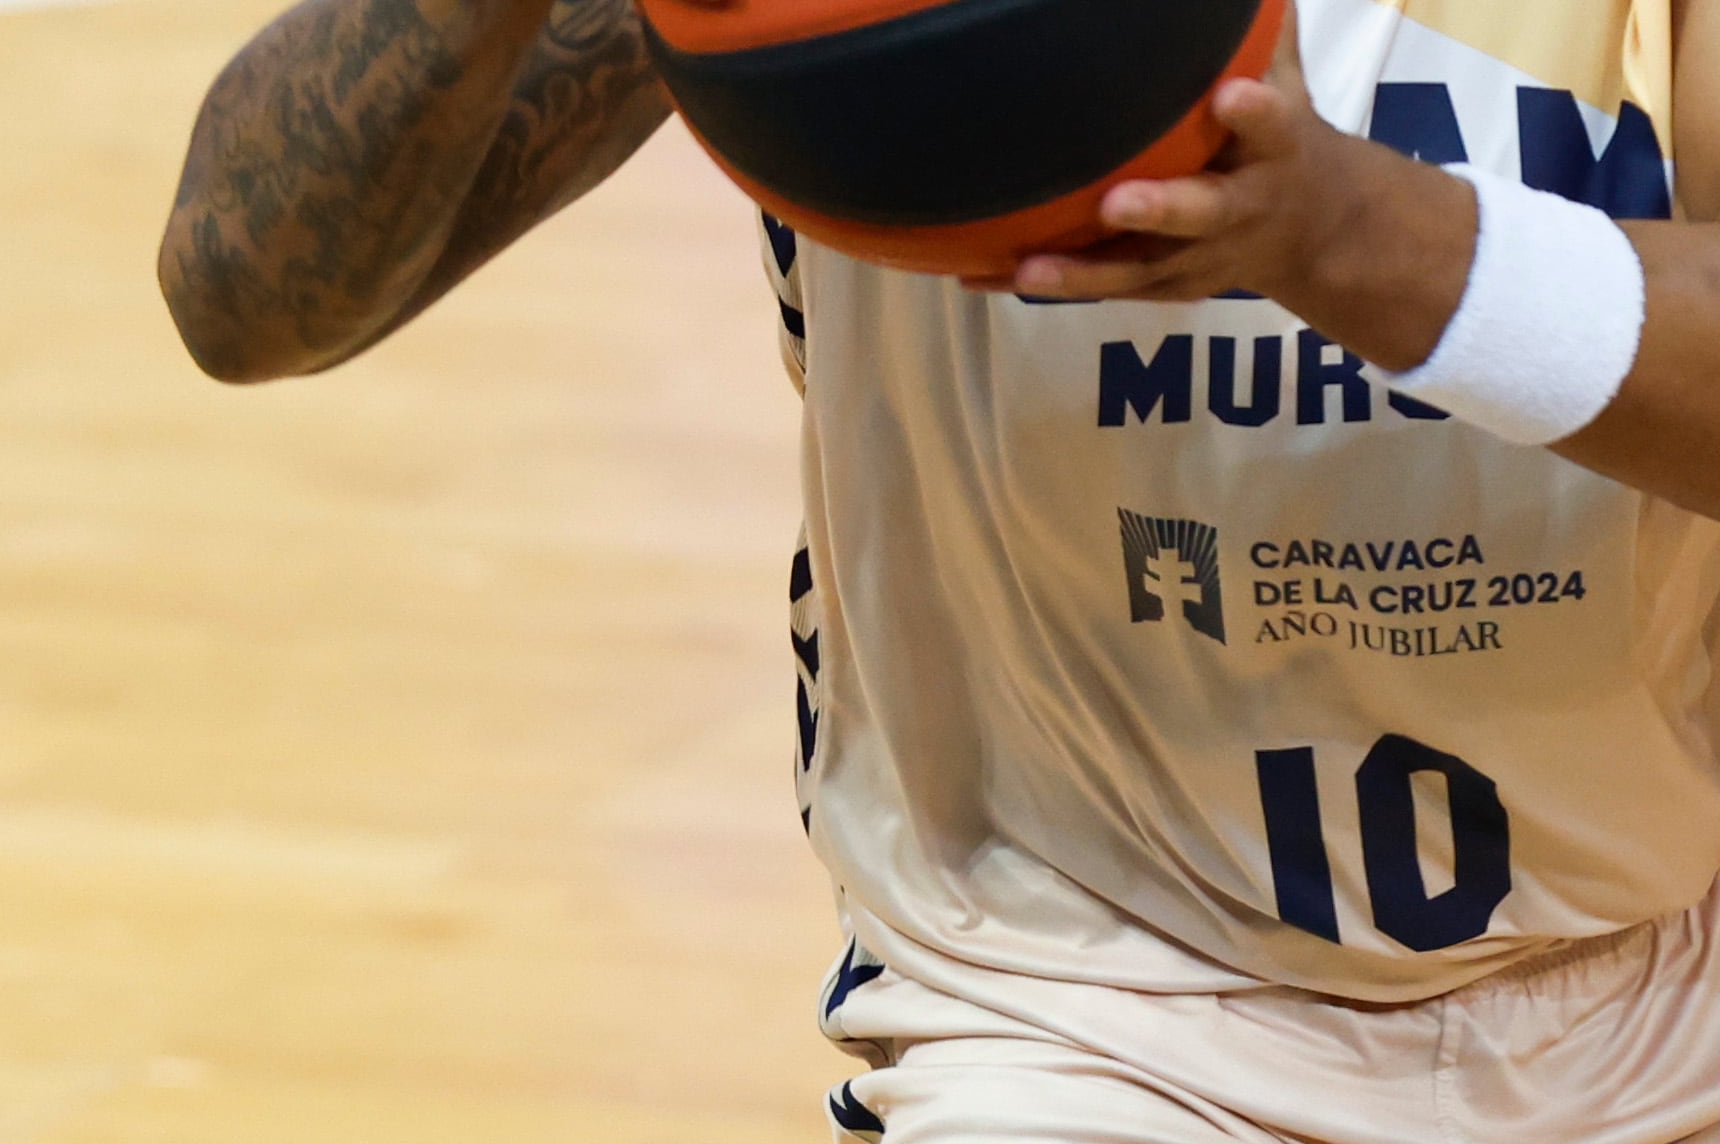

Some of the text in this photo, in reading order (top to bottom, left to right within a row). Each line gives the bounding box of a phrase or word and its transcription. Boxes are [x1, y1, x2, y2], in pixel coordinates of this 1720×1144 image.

[1097, 327, 1452, 428] MUR
[1250, 534, 1484, 572] CARAVACA
[1253, 569, 1587, 615] DE LA CRUZ 2024
[1254, 611, 1504, 657] AÑO JUBILAR
[1254, 732, 1512, 953] 10
